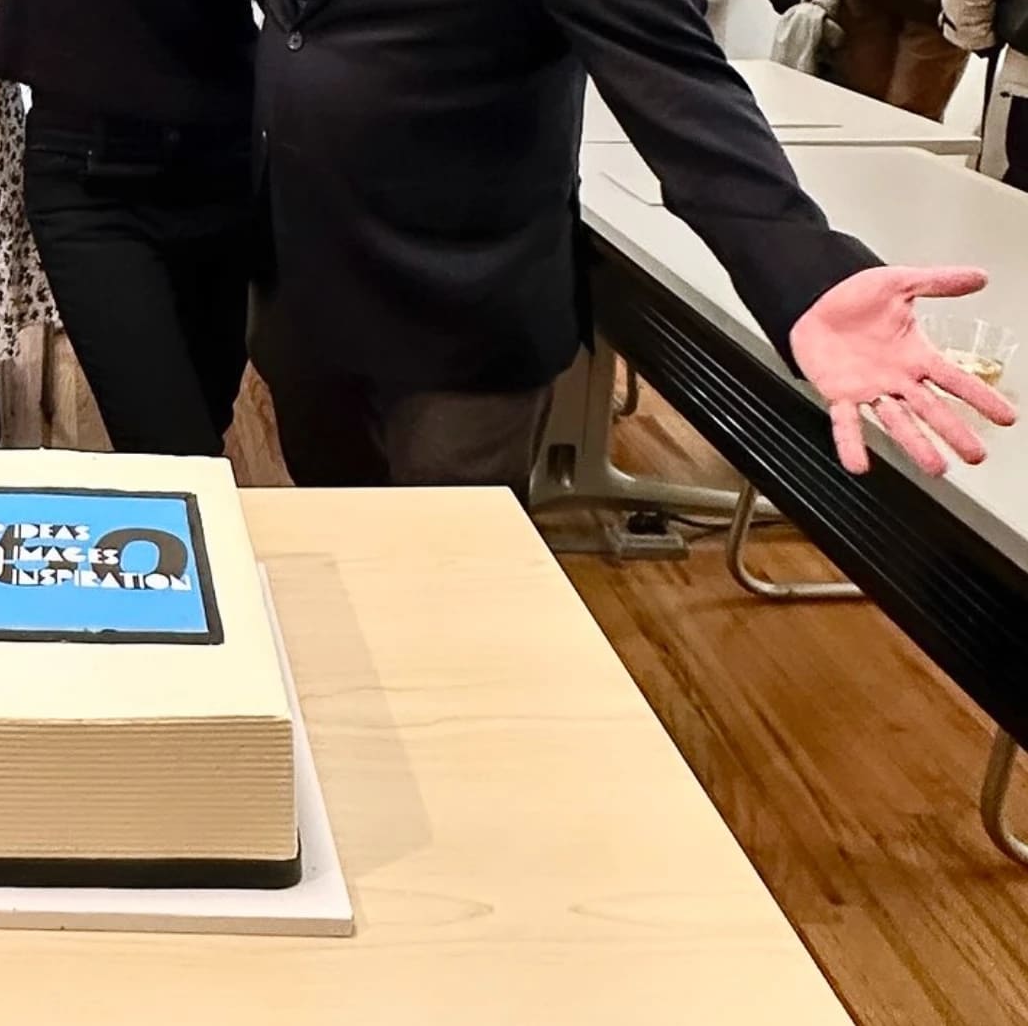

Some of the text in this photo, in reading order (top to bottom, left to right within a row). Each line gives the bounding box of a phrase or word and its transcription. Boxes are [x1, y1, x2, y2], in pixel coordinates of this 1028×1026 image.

[13, 523, 90, 541] IDEAS
[13, 545, 119, 565] IMAGES
[11, 568, 192, 590] INSPIRATION
